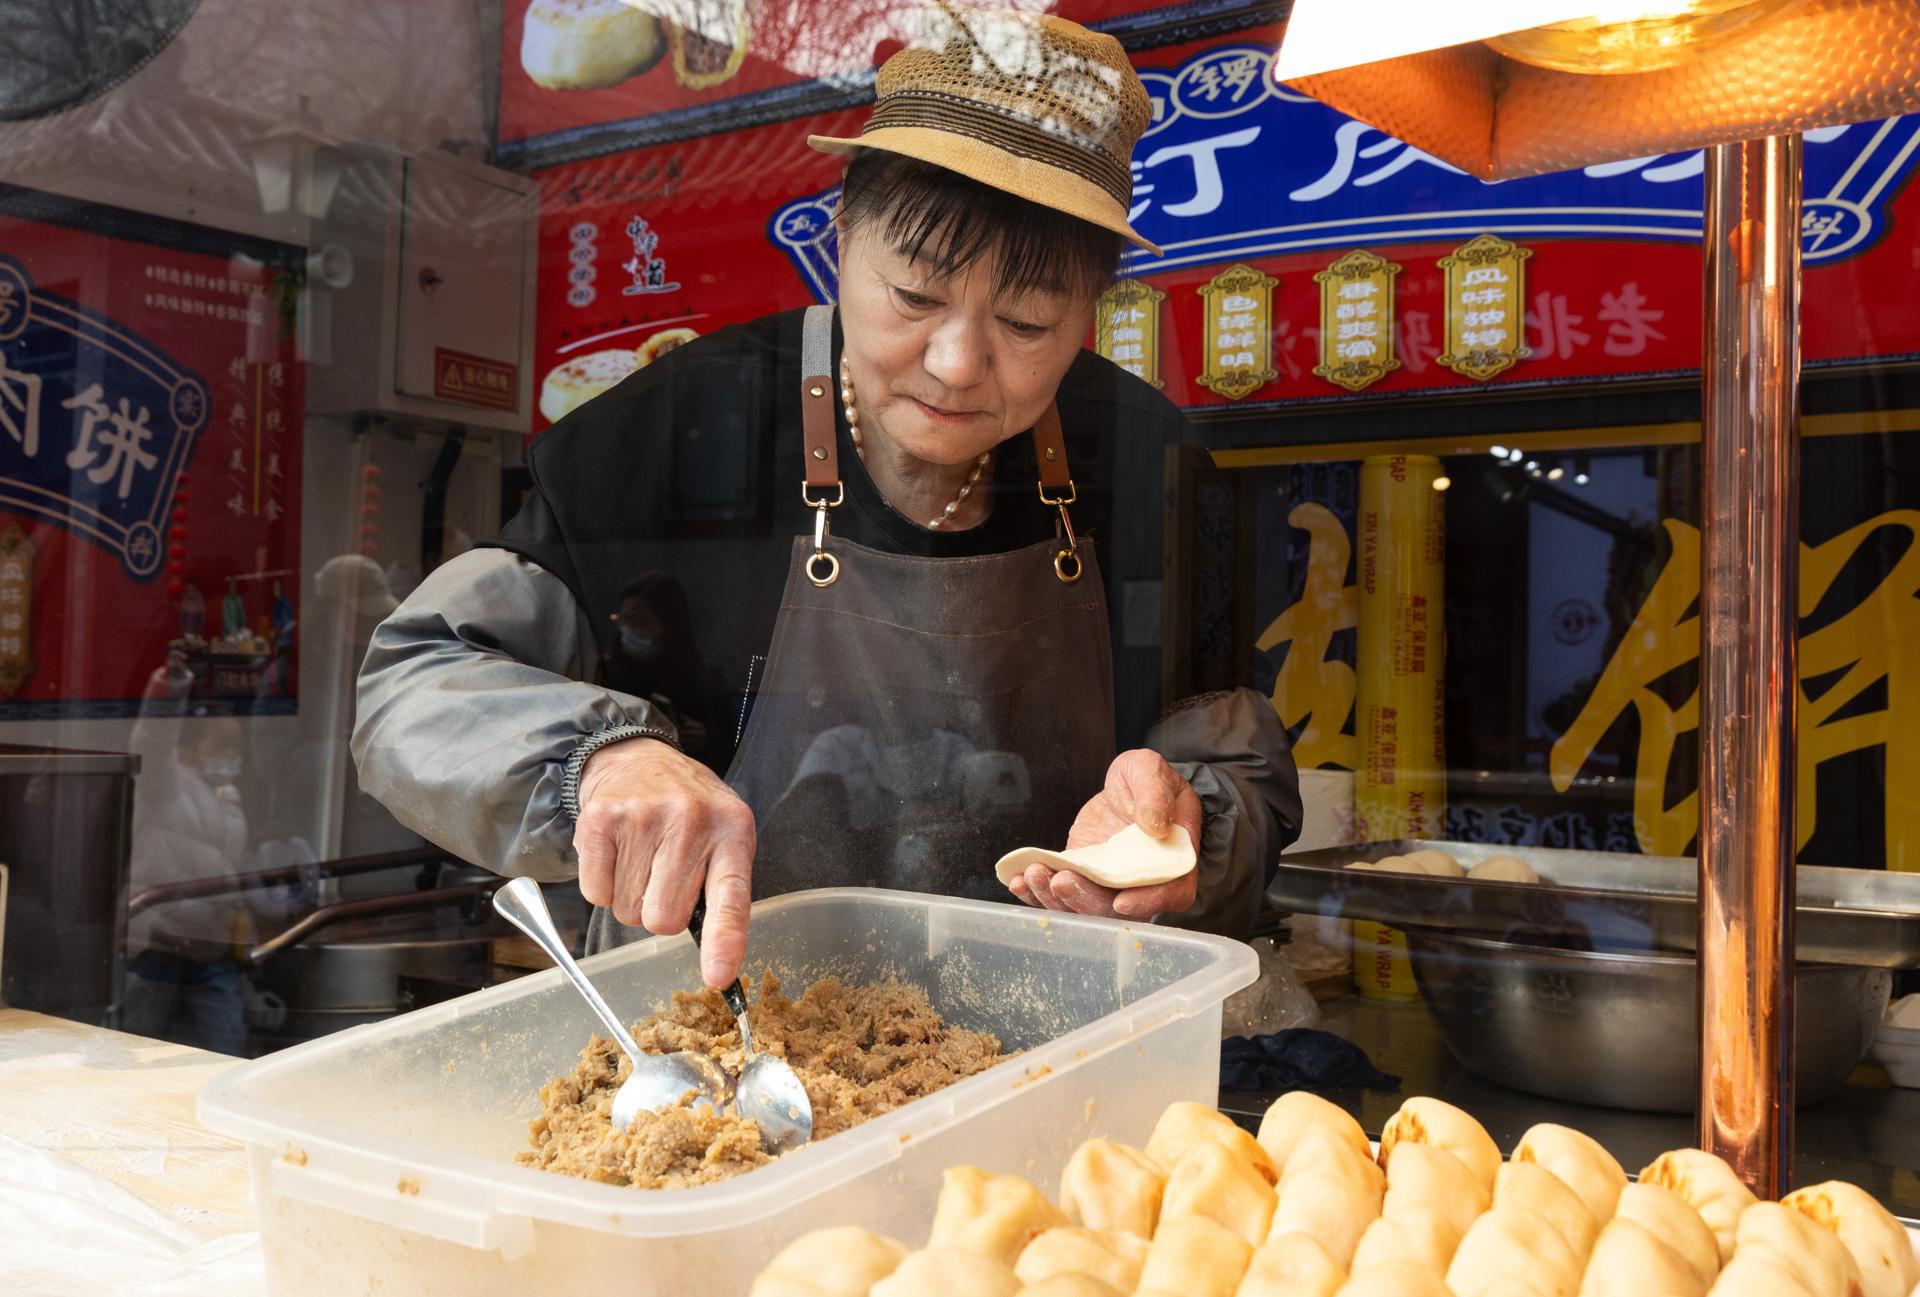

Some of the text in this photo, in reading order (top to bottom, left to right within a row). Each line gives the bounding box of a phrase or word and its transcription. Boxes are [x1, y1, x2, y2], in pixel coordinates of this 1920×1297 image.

[1460, 266, 1510, 348] 风味独特
[1363, 511, 1377, 595] XIN YA WRAP
[1407, 790, 1424, 834] XIN YA
[1375, 928, 1393, 989] YA WRAP
